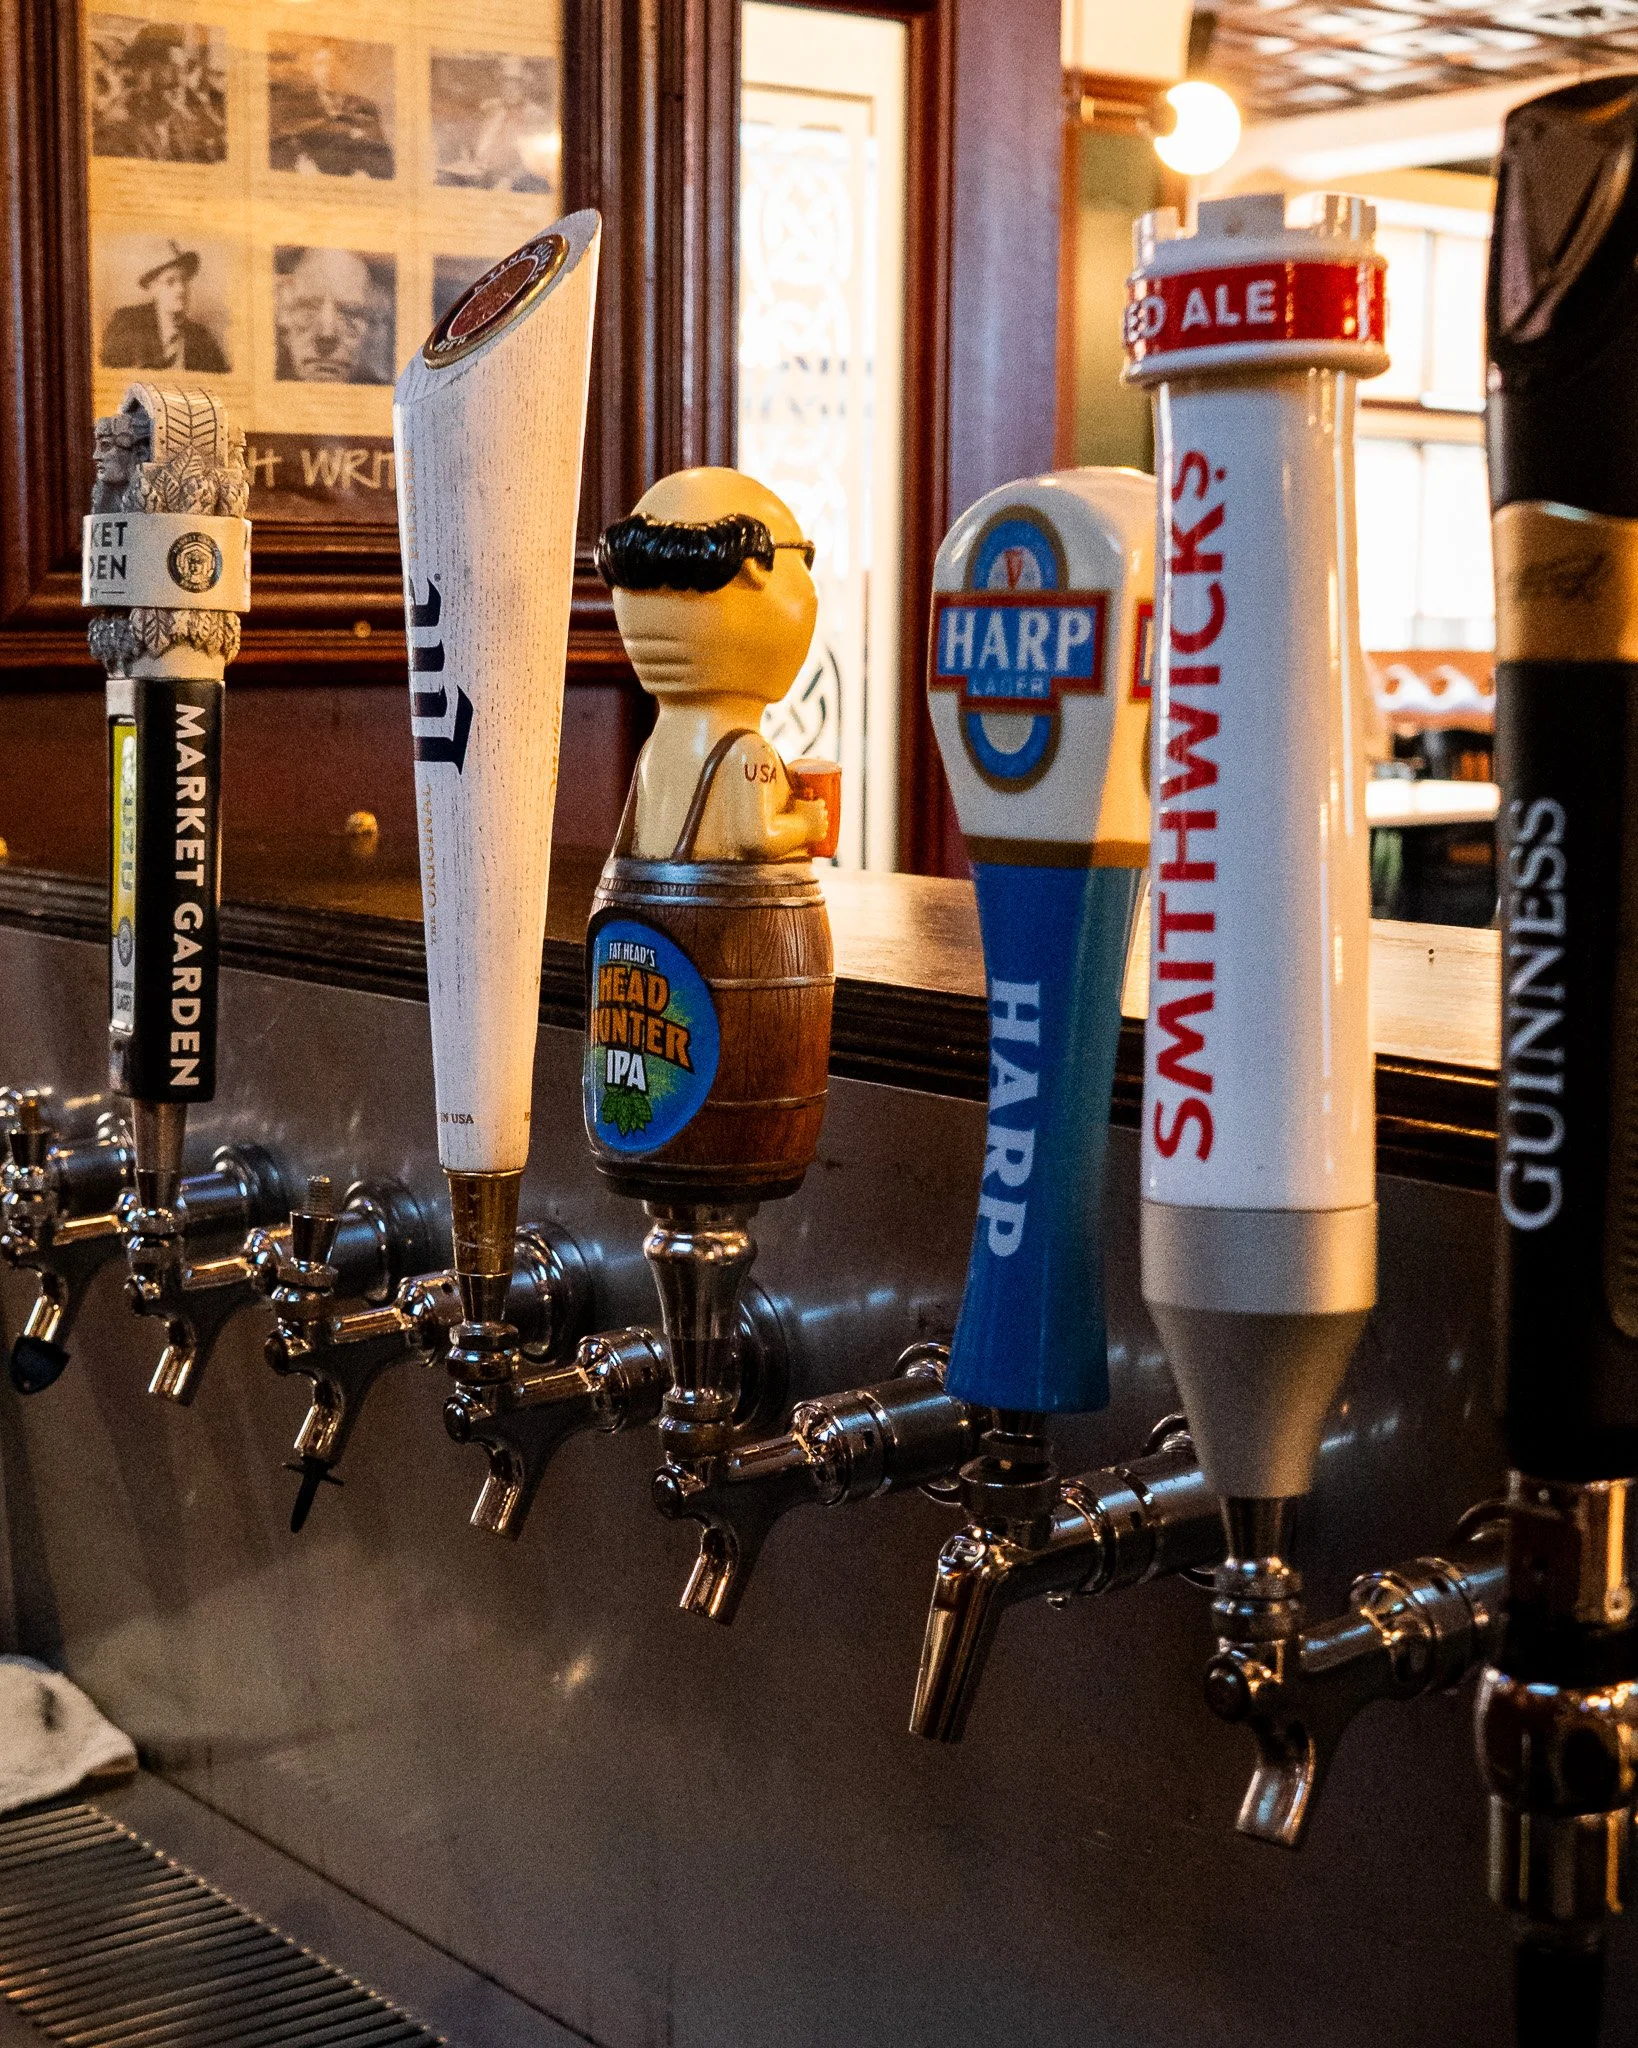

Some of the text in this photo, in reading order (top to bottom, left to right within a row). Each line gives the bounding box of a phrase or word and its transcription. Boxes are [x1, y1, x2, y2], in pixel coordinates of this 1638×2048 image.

[1181, 279, 1277, 332] ALE
[945, 610, 1092, 671] HARP
[744, 763, 777, 783] USA
[170, 703, 206, 1086] MARKET GARDEN
[609, 942, 656, 968] FAT HEAD'S
[598, 966, 669, 1012] HEAD
[1501, 796, 1567, 1231] GUINNESS
[607, 1050, 647, 1092] IPA
[451, 1113, 475, 1125] USA
[978, 976, 1041, 1258] HARP
